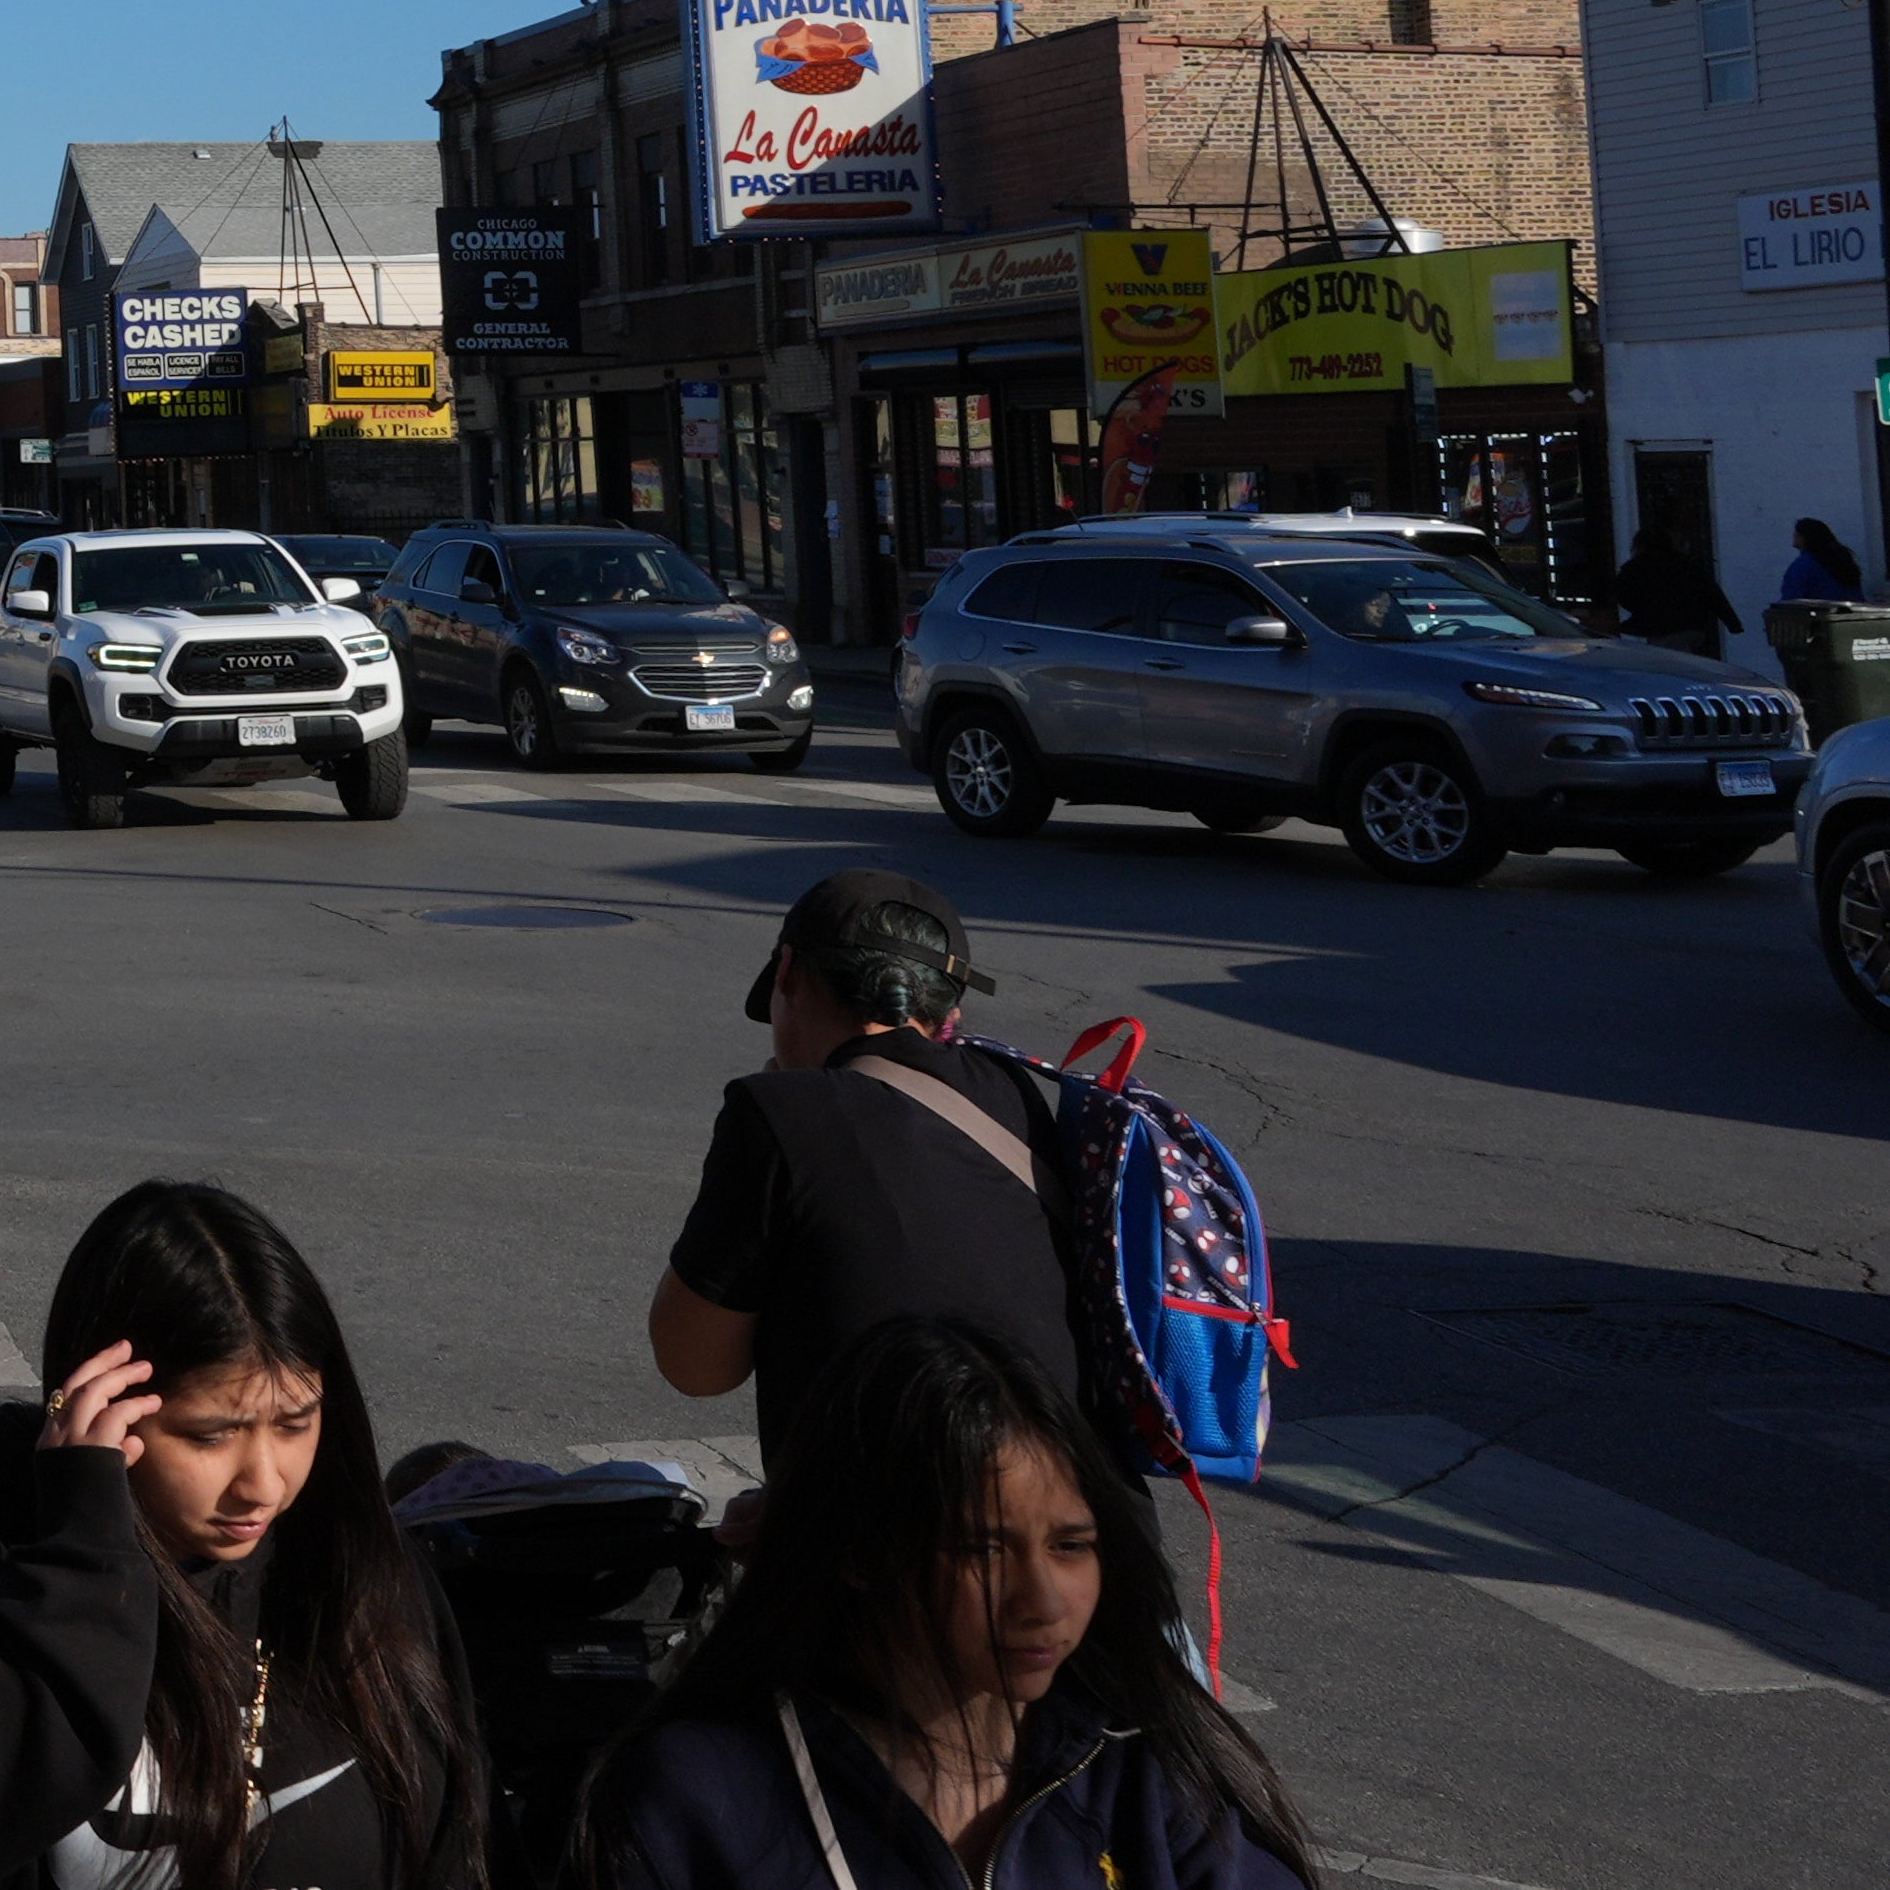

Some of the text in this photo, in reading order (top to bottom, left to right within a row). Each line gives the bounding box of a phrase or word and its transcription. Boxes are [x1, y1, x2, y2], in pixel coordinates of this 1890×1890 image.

[723, 104, 922, 171] La Canasta
[730, 167, 920, 198] PASTELERIA
[1768, 189, 1870, 222] IGLESIA
[477, 218, 538, 230] CHICAGO
[450, 230, 566, 250] COMMON
[1744, 236, 1778, 271] EL
[1793, 226, 1865, 267] LIRIO
[452, 250, 566, 261] CONSTRUCTION
[819, 246, 1078, 307] PANADERIA La Canasta
[950, 283, 1017, 305] FRENCH
[1105, 281, 1208, 297] VIENNA BEEF
[122, 295, 242, 322] CHECKS
[473, 322, 551, 334] GENERAL
[1224, 270, 1454, 373] JACK'S HOT DOG
[124, 323, 242, 349] CASHED
[455, 337, 570, 350] CONTRACTOR
[136, 356, 161, 367] HABLA
[1103, 355, 1147, 374] HOT
[337, 365, 416, 376] WESTERN
[362, 376, 416, 387] UNION
[125, 390, 227, 407] WESTERN
[160, 402, 227, 419] UNION
[324, 404, 437, 421] Auto License
[376, 424, 388, 437] Y
[392, 422, 449, 438] Placas
[225, 655, 296, 669] TOYOTA
